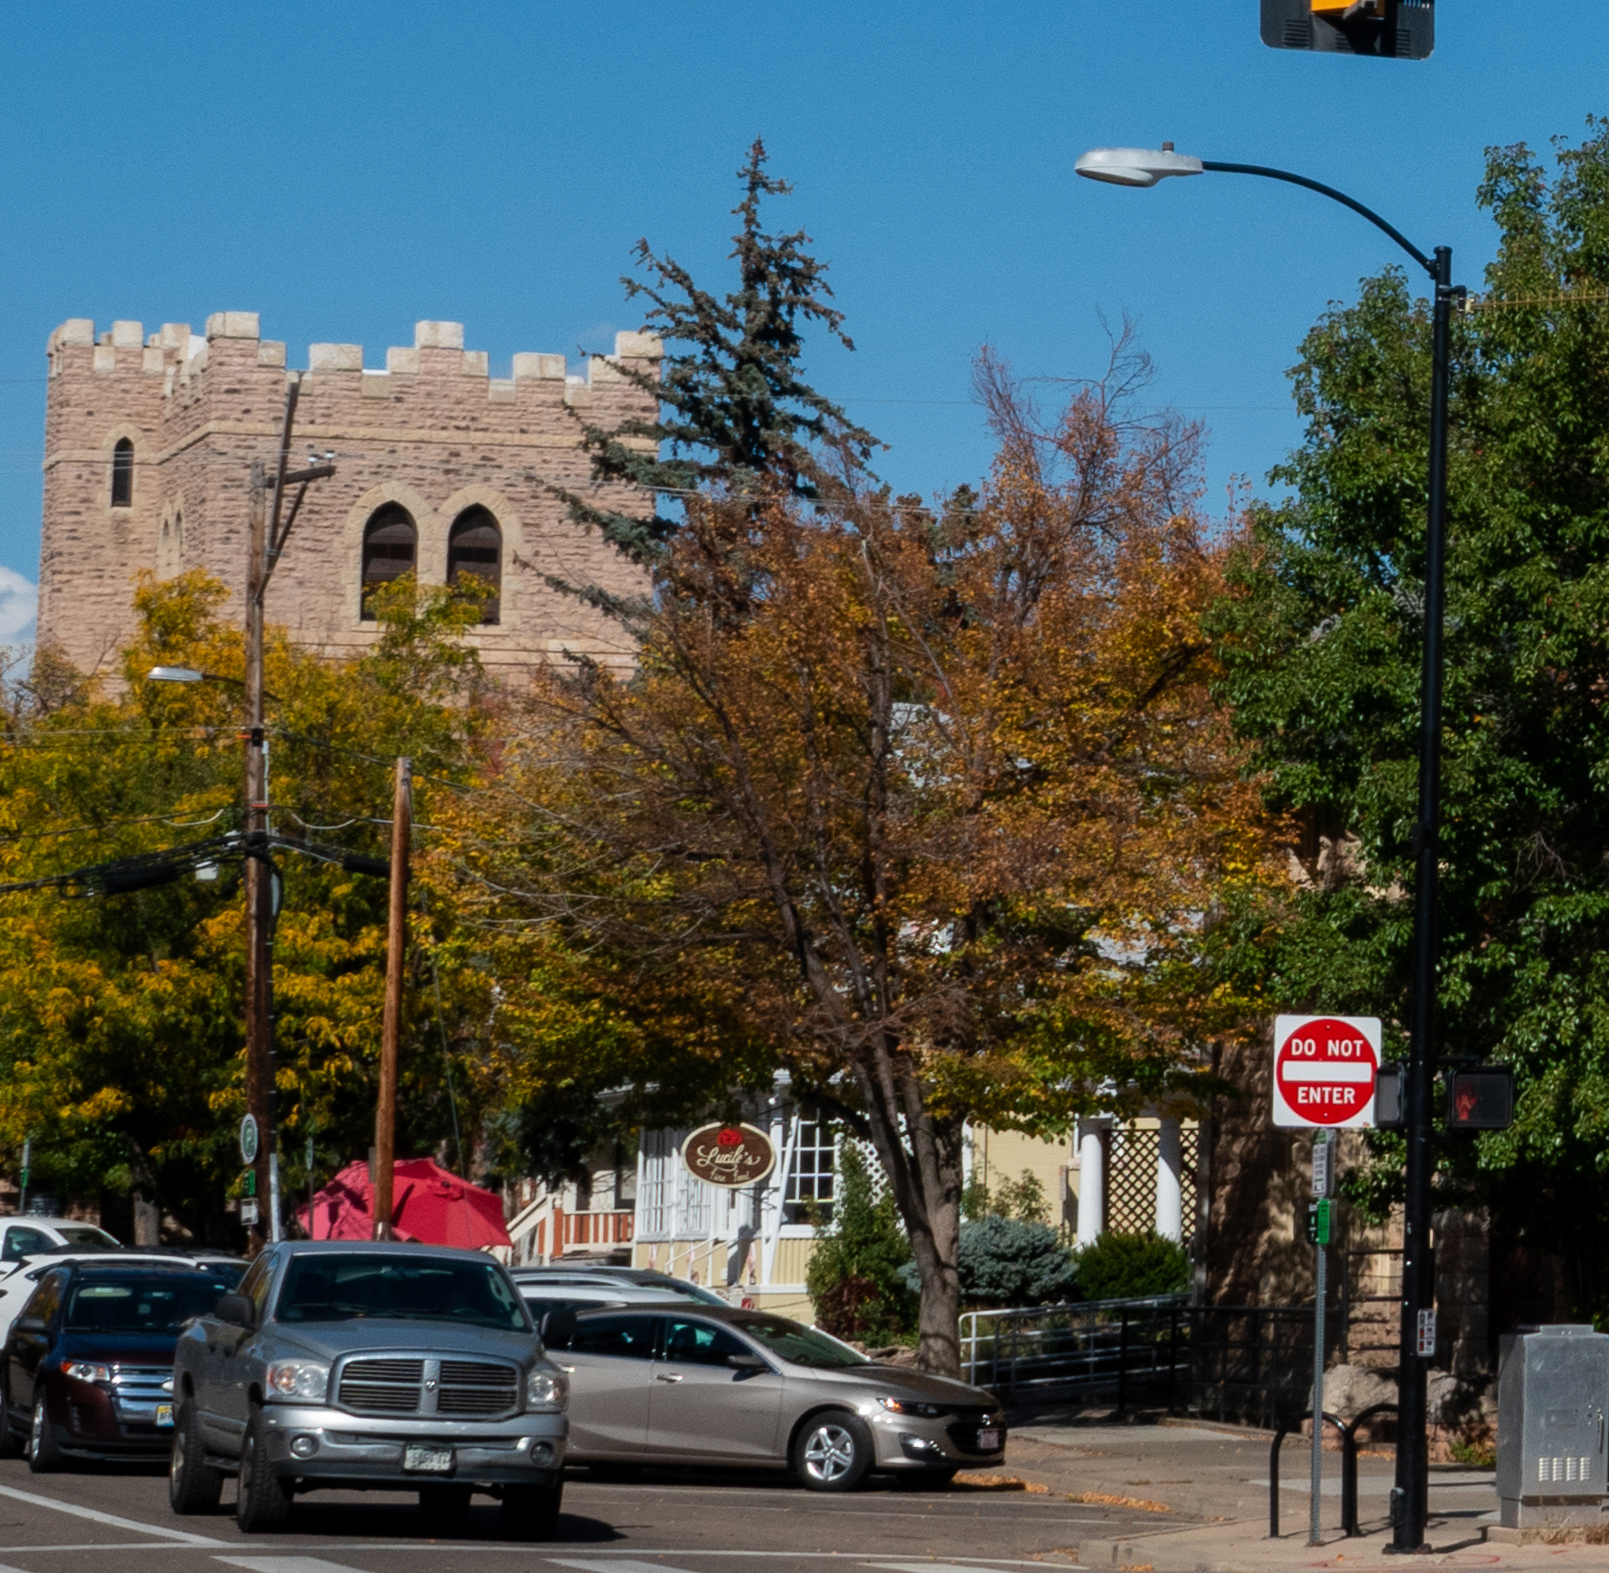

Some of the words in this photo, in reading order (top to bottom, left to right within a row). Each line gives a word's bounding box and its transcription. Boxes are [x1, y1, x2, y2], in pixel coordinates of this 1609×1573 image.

[1291, 1038, 1316, 1056] DO
[1327, 1039, 1364, 1057] NOT
[1297, 1086, 1356, 1104] ENTER
[696, 1143, 761, 1172] Lucile's
